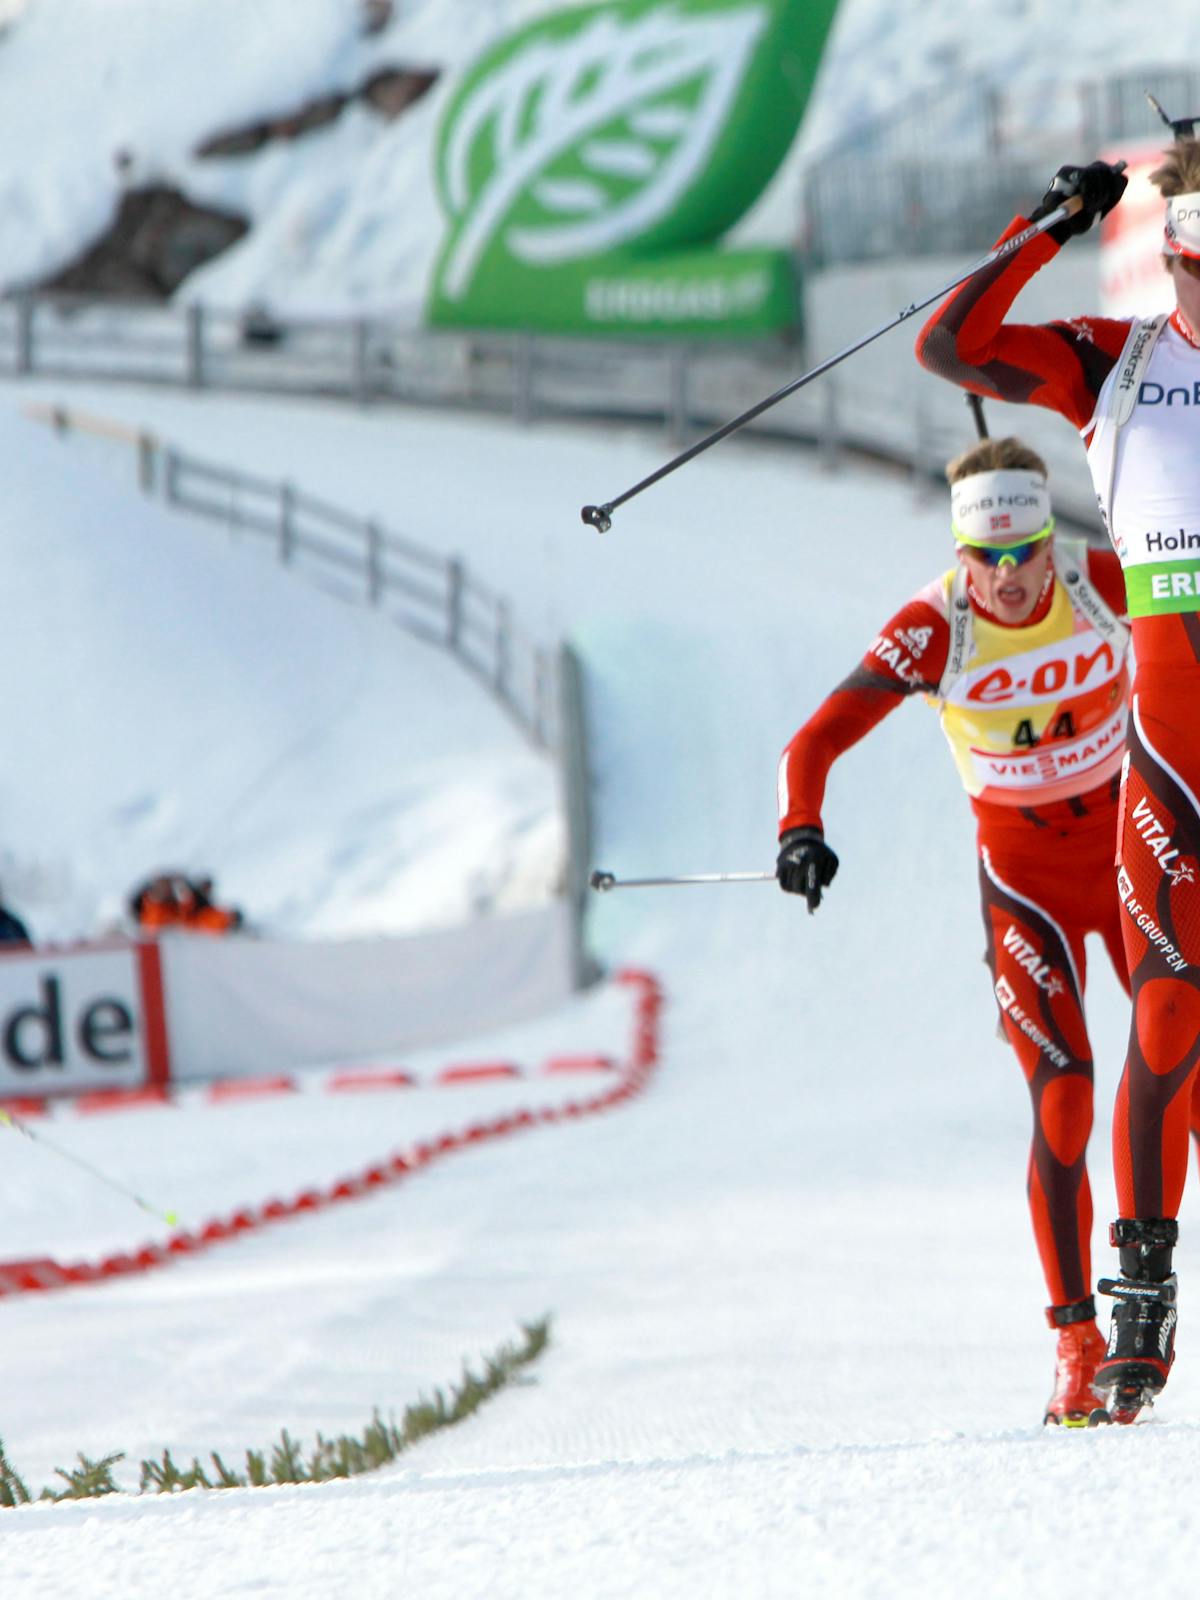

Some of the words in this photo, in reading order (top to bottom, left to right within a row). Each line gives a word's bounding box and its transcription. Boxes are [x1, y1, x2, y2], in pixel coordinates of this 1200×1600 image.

[1119, 332, 1152, 391] Statkraft
[1131, 796, 1179, 871] VITAL
[1002, 924, 1052, 989] VITAL
[1125, 898, 1141, 917] AF
[1136, 910, 1189, 973] GRUPPEN
